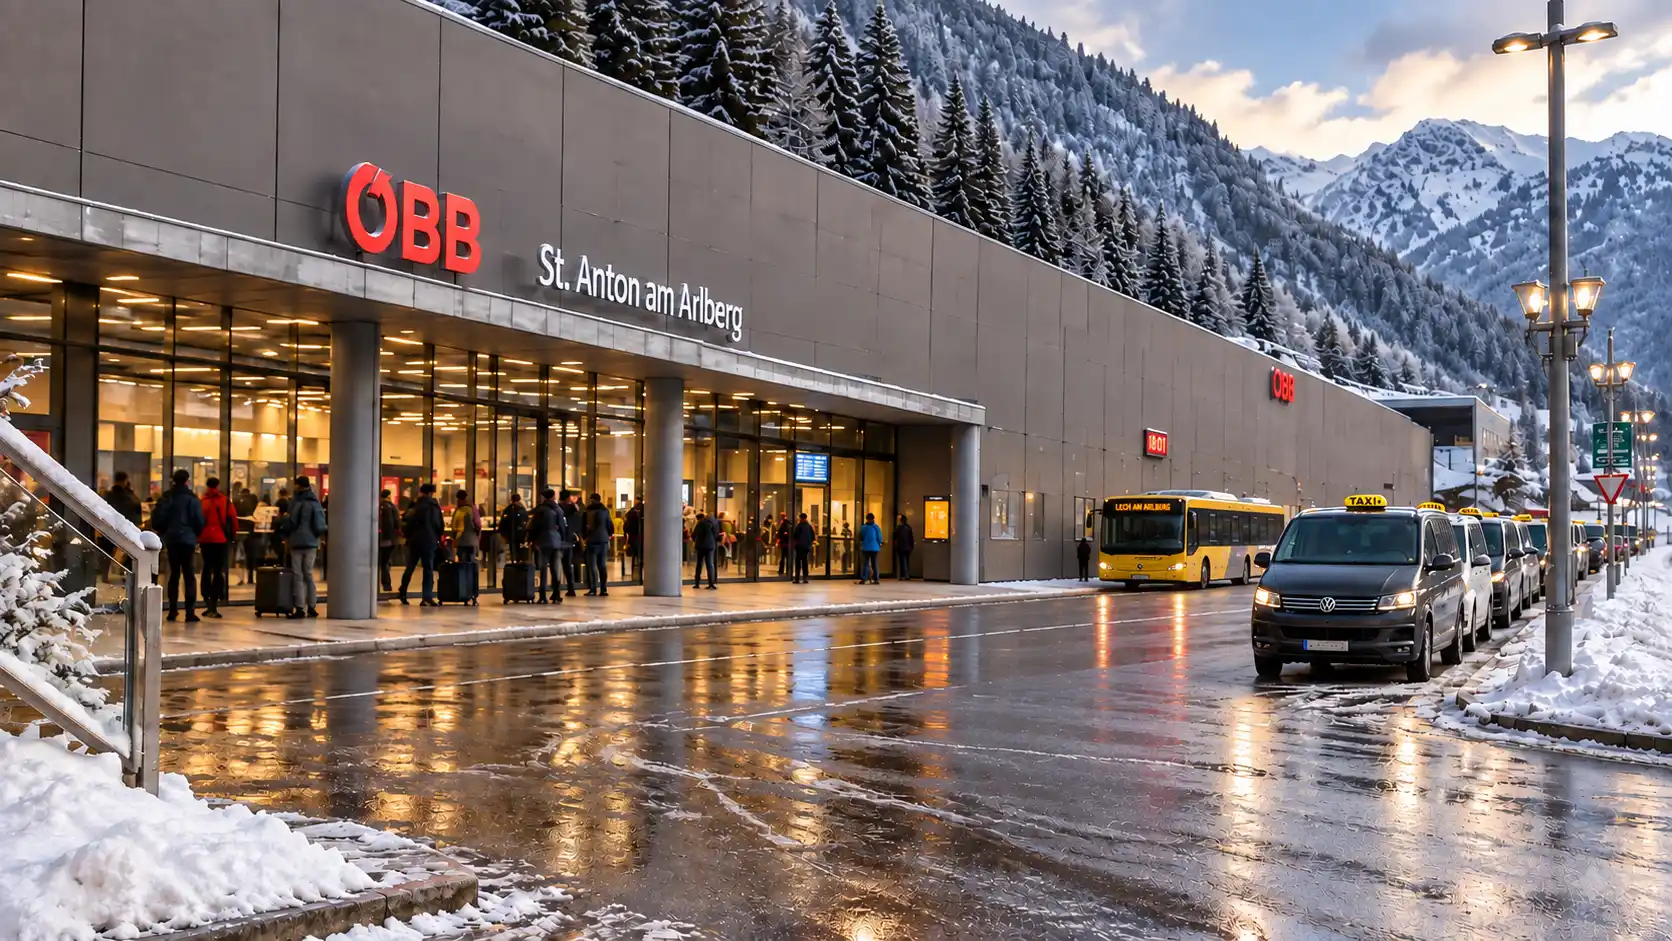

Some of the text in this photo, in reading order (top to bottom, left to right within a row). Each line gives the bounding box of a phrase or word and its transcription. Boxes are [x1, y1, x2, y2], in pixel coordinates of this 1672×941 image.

[538, 242, 743, 342] St. Anton am Arlberg
[1349, 496, 1377, 506] TAXI
